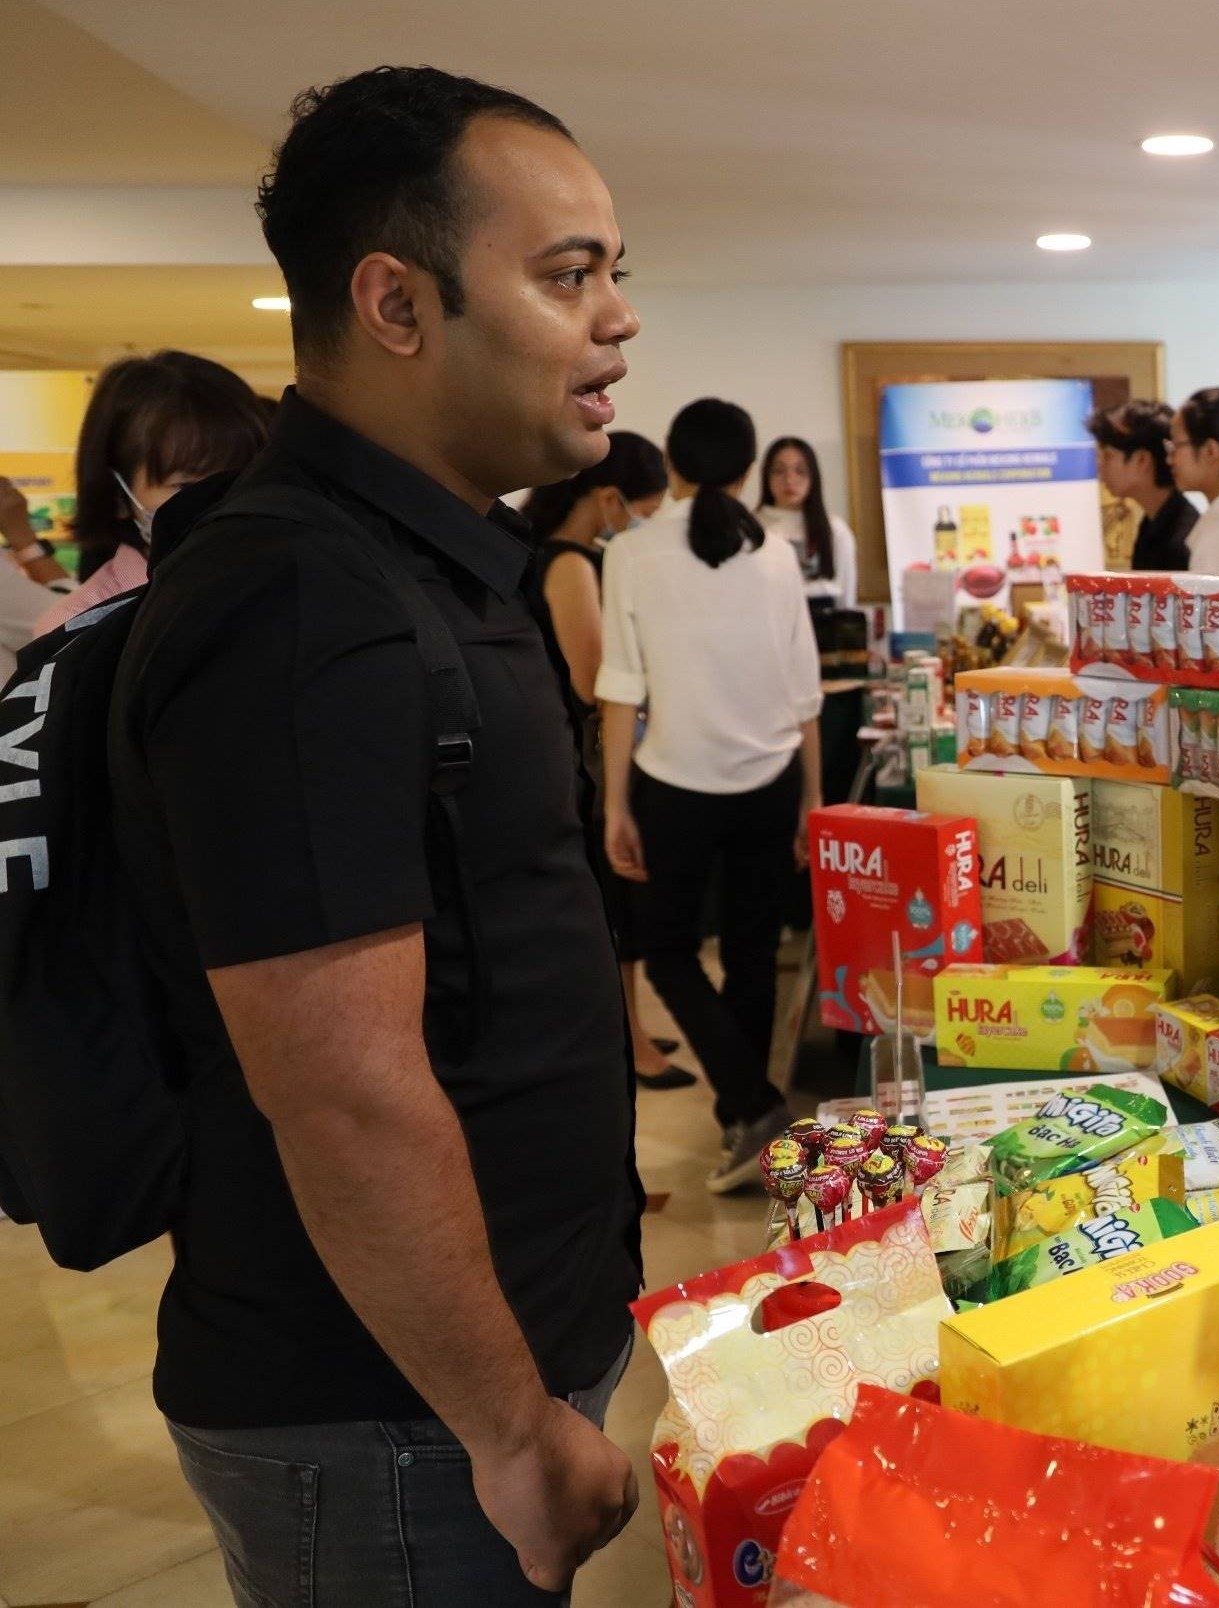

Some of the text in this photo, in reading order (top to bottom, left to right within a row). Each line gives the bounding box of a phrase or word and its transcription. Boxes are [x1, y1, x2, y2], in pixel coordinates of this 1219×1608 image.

[1074, 792, 1091, 866] HURA
[819, 838, 882, 878] HURA
[955, 830, 974, 891] HURA
[1012, 856, 1048, 894] deli
[1092, 843, 1131, 875] HURA
[947, 997, 1012, 1025] HURA
